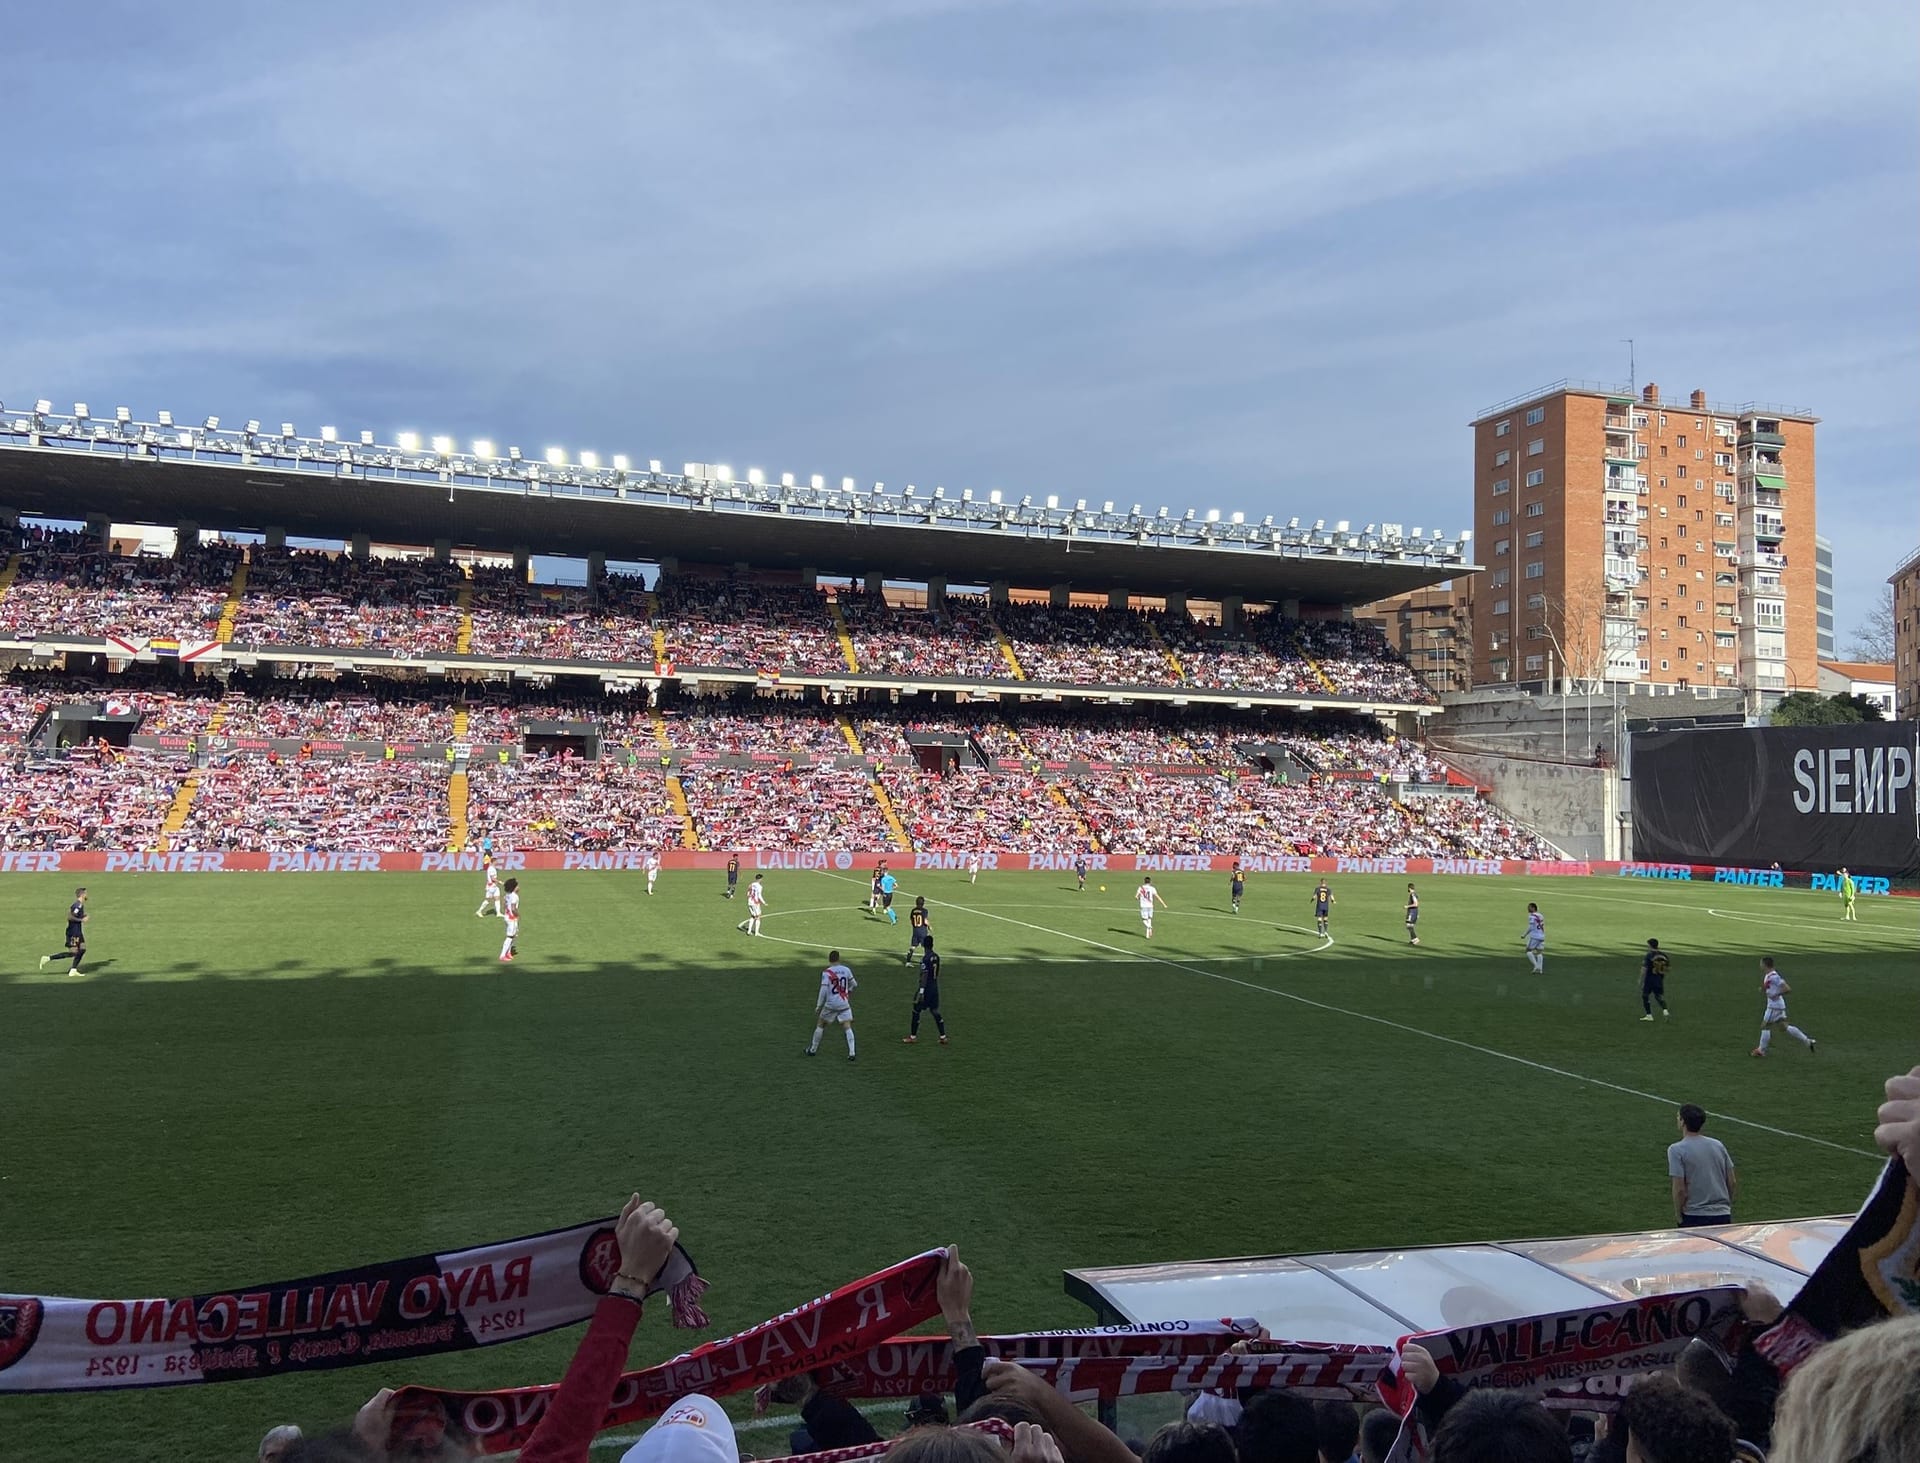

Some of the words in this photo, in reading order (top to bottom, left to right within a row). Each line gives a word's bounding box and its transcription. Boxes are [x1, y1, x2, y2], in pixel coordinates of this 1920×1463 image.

[1793, 747, 1911, 814] SIEMP
[104, 851, 225, 872] PANTER
[267, 851, 381, 871] PANTER
[757, 851, 829, 870] LALIGA
[914, 851, 998, 870] PANTR
[1135, 854, 1212, 871] PANTER
[1239, 856, 1312, 872] PANTER
[1337, 857, 1407, 873] PANTER
[1432, 858, 1501, 874] PANTER
[1619, 861, 1692, 881] PANTER
[1714, 866, 1784, 888] PANTER
[1319, 892, 1327, 902] 8
[912, 914, 923, 928] 10
[831, 976, 847, 995] 20
[1103, 1320, 1190, 1334] CONTIGO
[1448, 1296, 1711, 1372] VALLECANO
